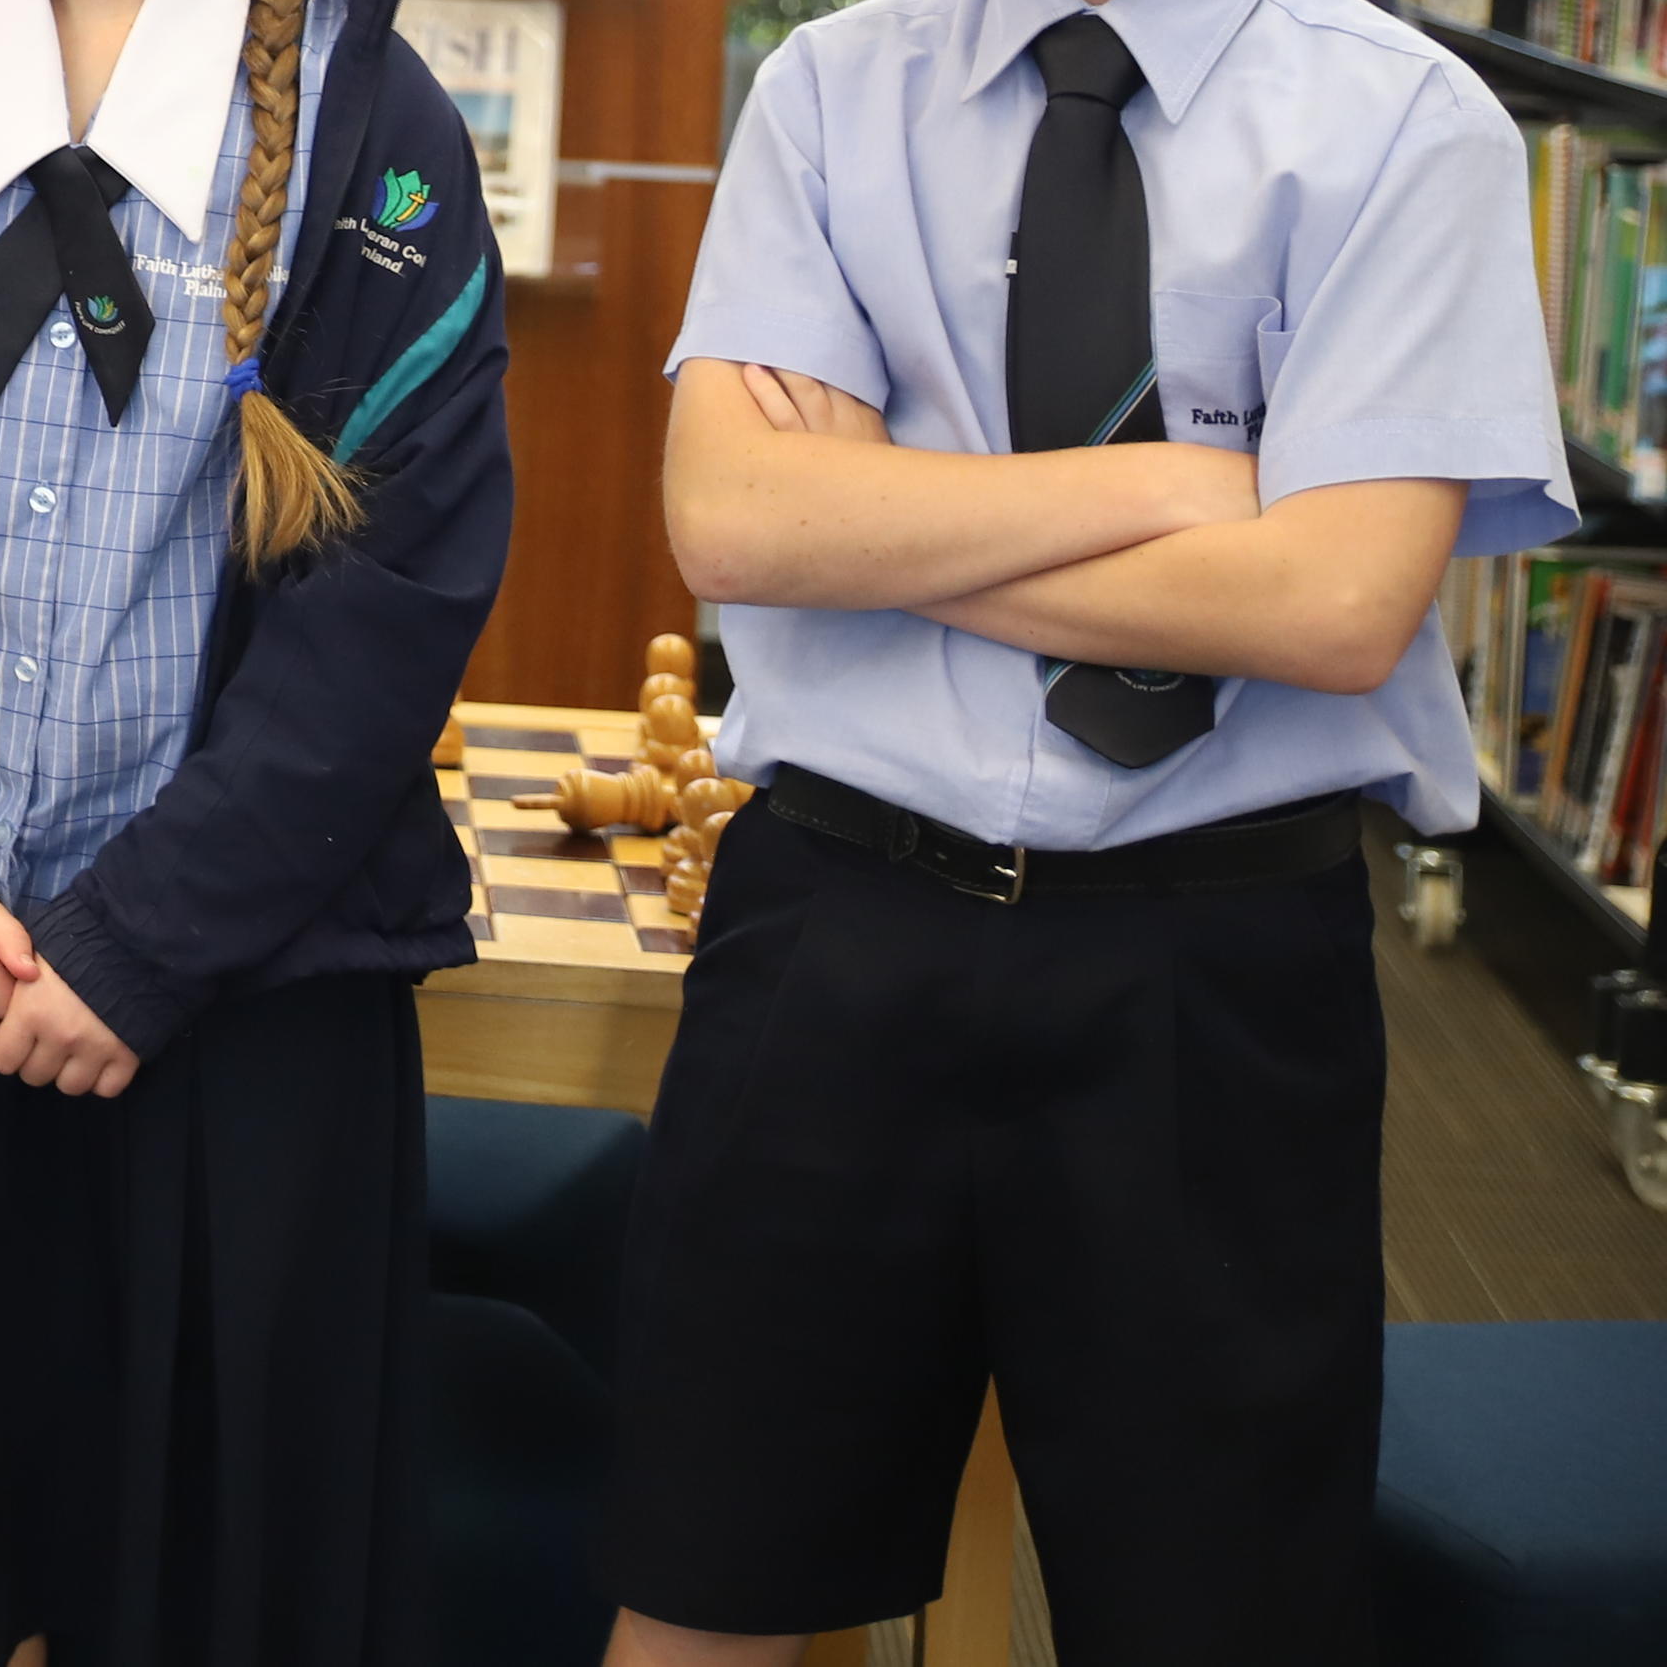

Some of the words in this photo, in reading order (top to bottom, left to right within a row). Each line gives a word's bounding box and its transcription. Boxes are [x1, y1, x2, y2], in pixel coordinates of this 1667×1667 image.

[334, 216, 358, 231] aith
[135, 253, 179, 276] Faith
[179, 261, 226, 281] Luthe
[1192, 408, 1239, 426] Faith
